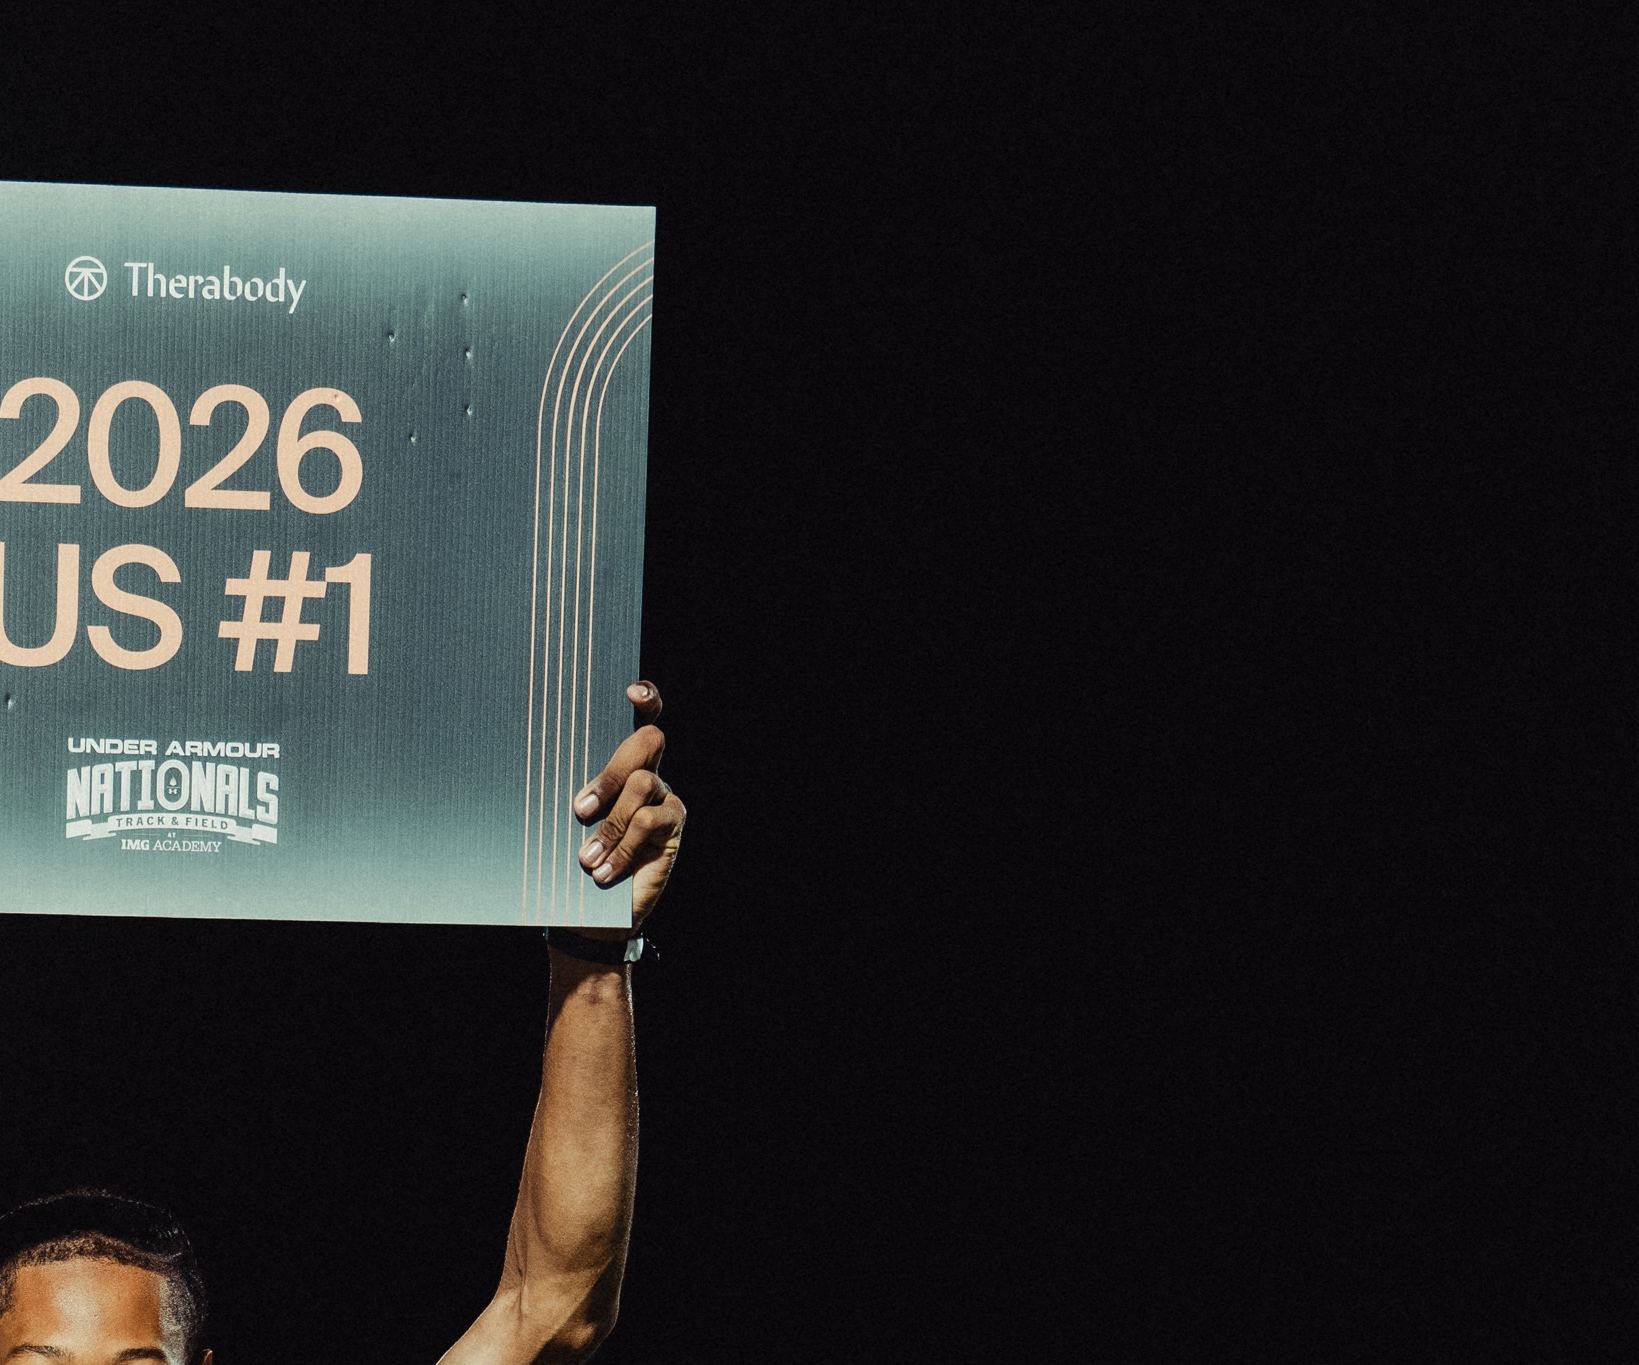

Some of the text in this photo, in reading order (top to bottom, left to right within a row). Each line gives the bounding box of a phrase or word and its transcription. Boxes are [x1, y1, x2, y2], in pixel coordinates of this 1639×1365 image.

[124, 262, 307, 314] Therabody
[217, 550, 373, 676] #1
[68, 737, 280, 758] UNDER ARMOUR
[66, 759, 279, 825] NATIONALS
[115, 815, 229, 830] TRACK & FIELD
[120, 839, 223, 852] IMG ACADEMY
